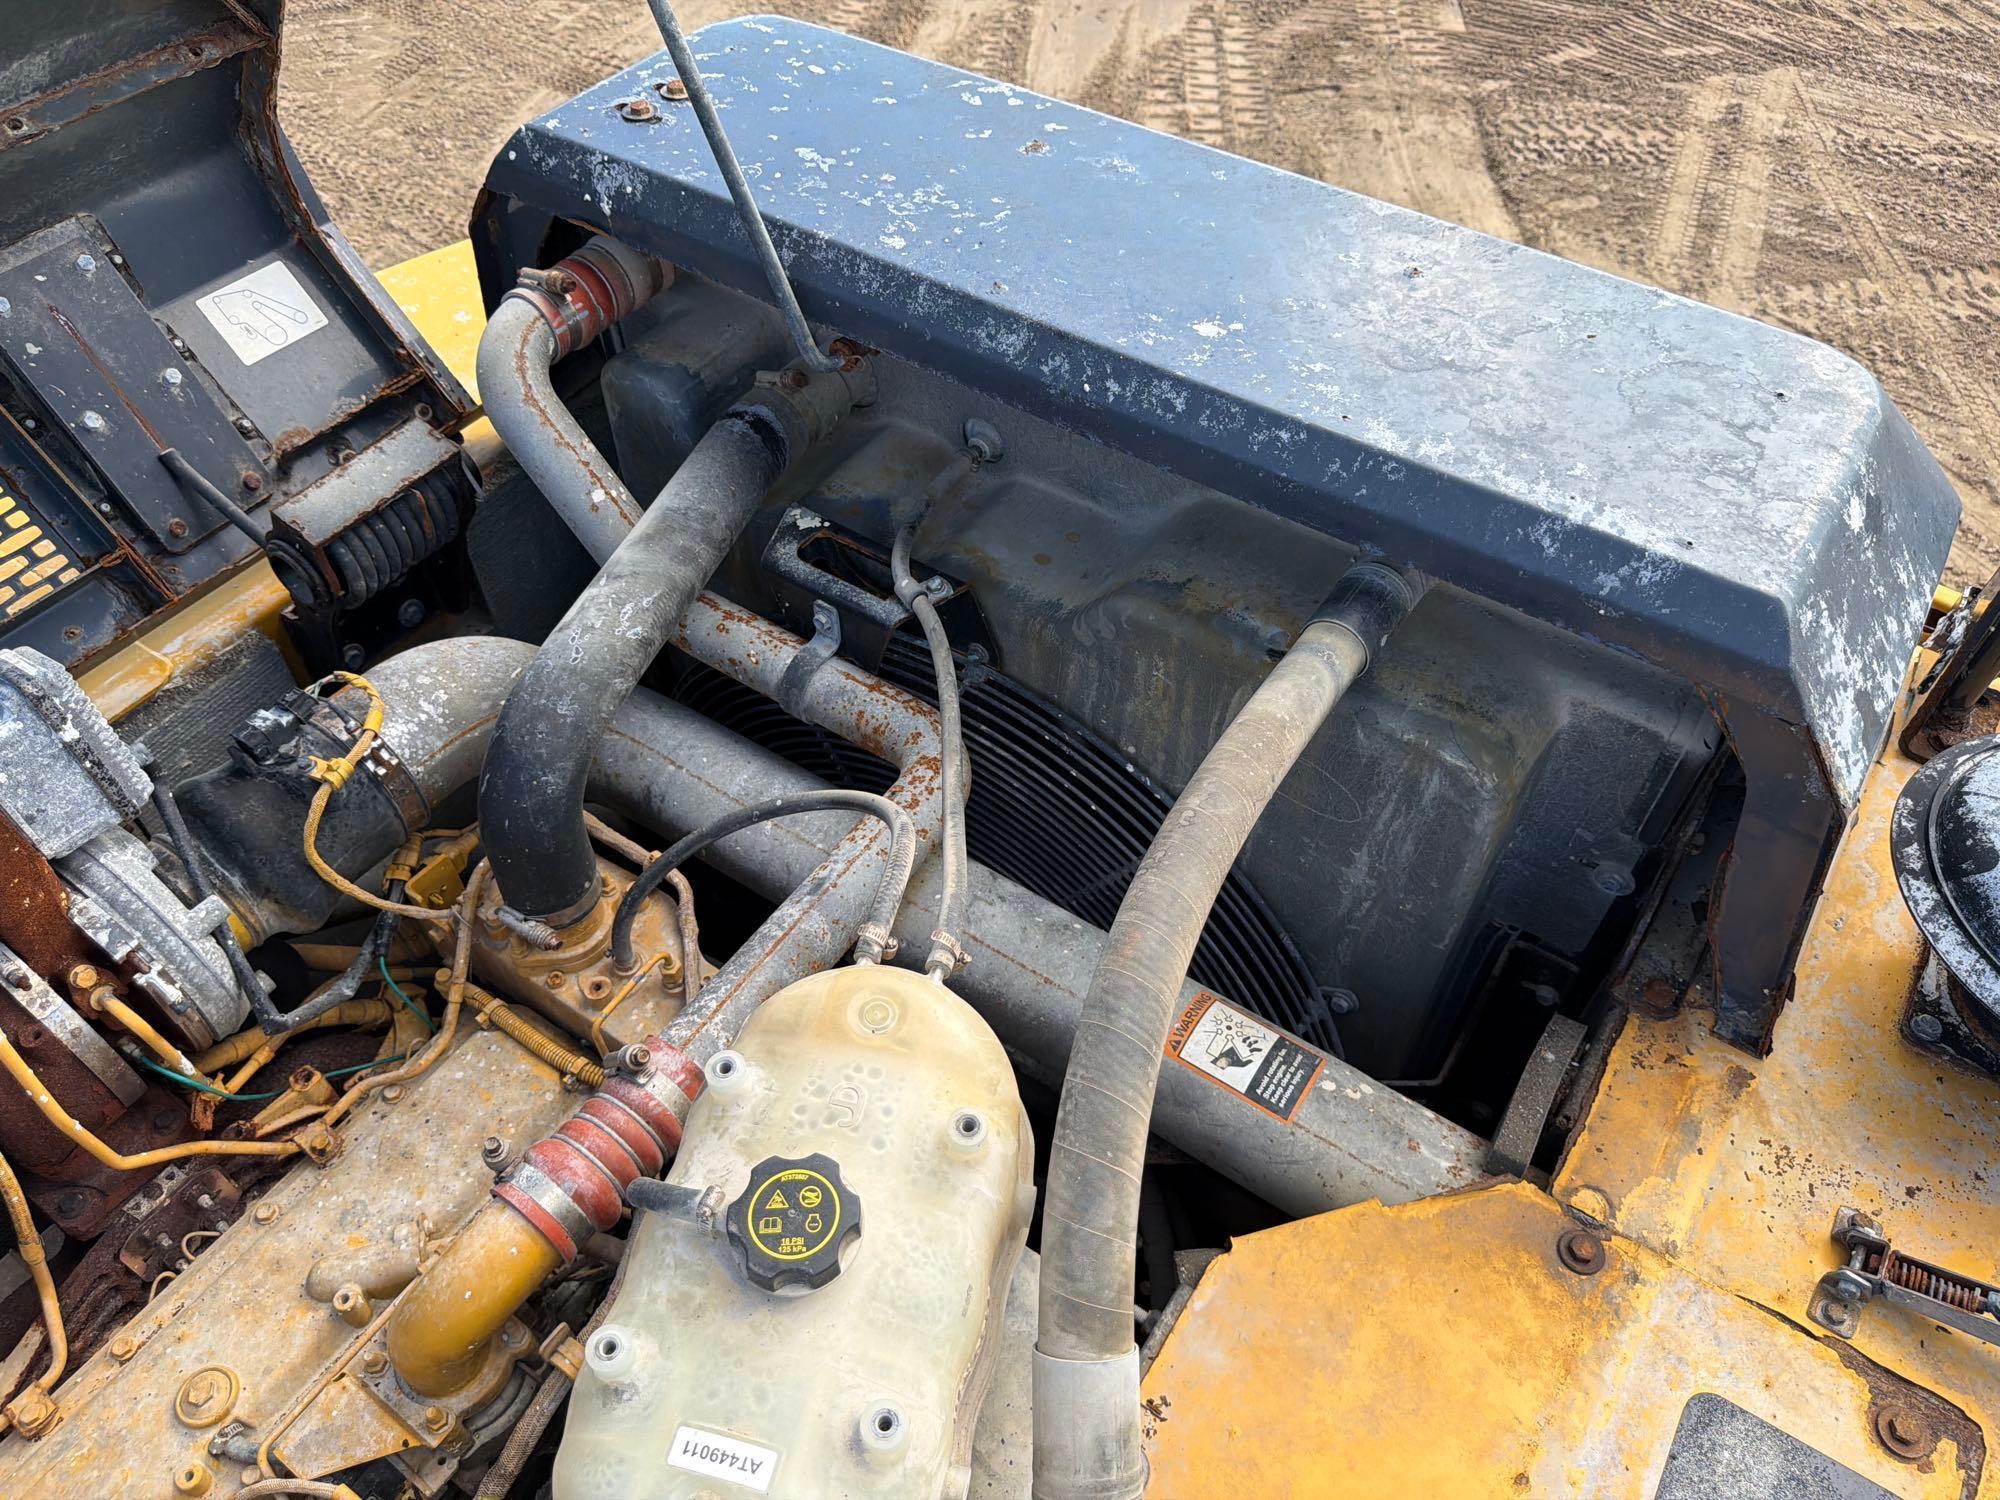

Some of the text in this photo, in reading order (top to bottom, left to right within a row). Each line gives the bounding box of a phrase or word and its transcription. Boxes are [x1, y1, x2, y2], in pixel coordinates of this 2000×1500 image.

[1175, 993, 1212, 1037] WARNING
[1255, 1075, 1270, 1095] Avoid
[1266, 1055, 1283, 1078] rotating
[1262, 1063, 1288, 1100] Stop engine.
[1270, 1053, 1303, 1104] Keep clear to avoid
[1278, 1084, 1295, 1108] serious
[792, 1245, 807, 1253] kPa
[682, 1440, 763, 1474] AT449011
